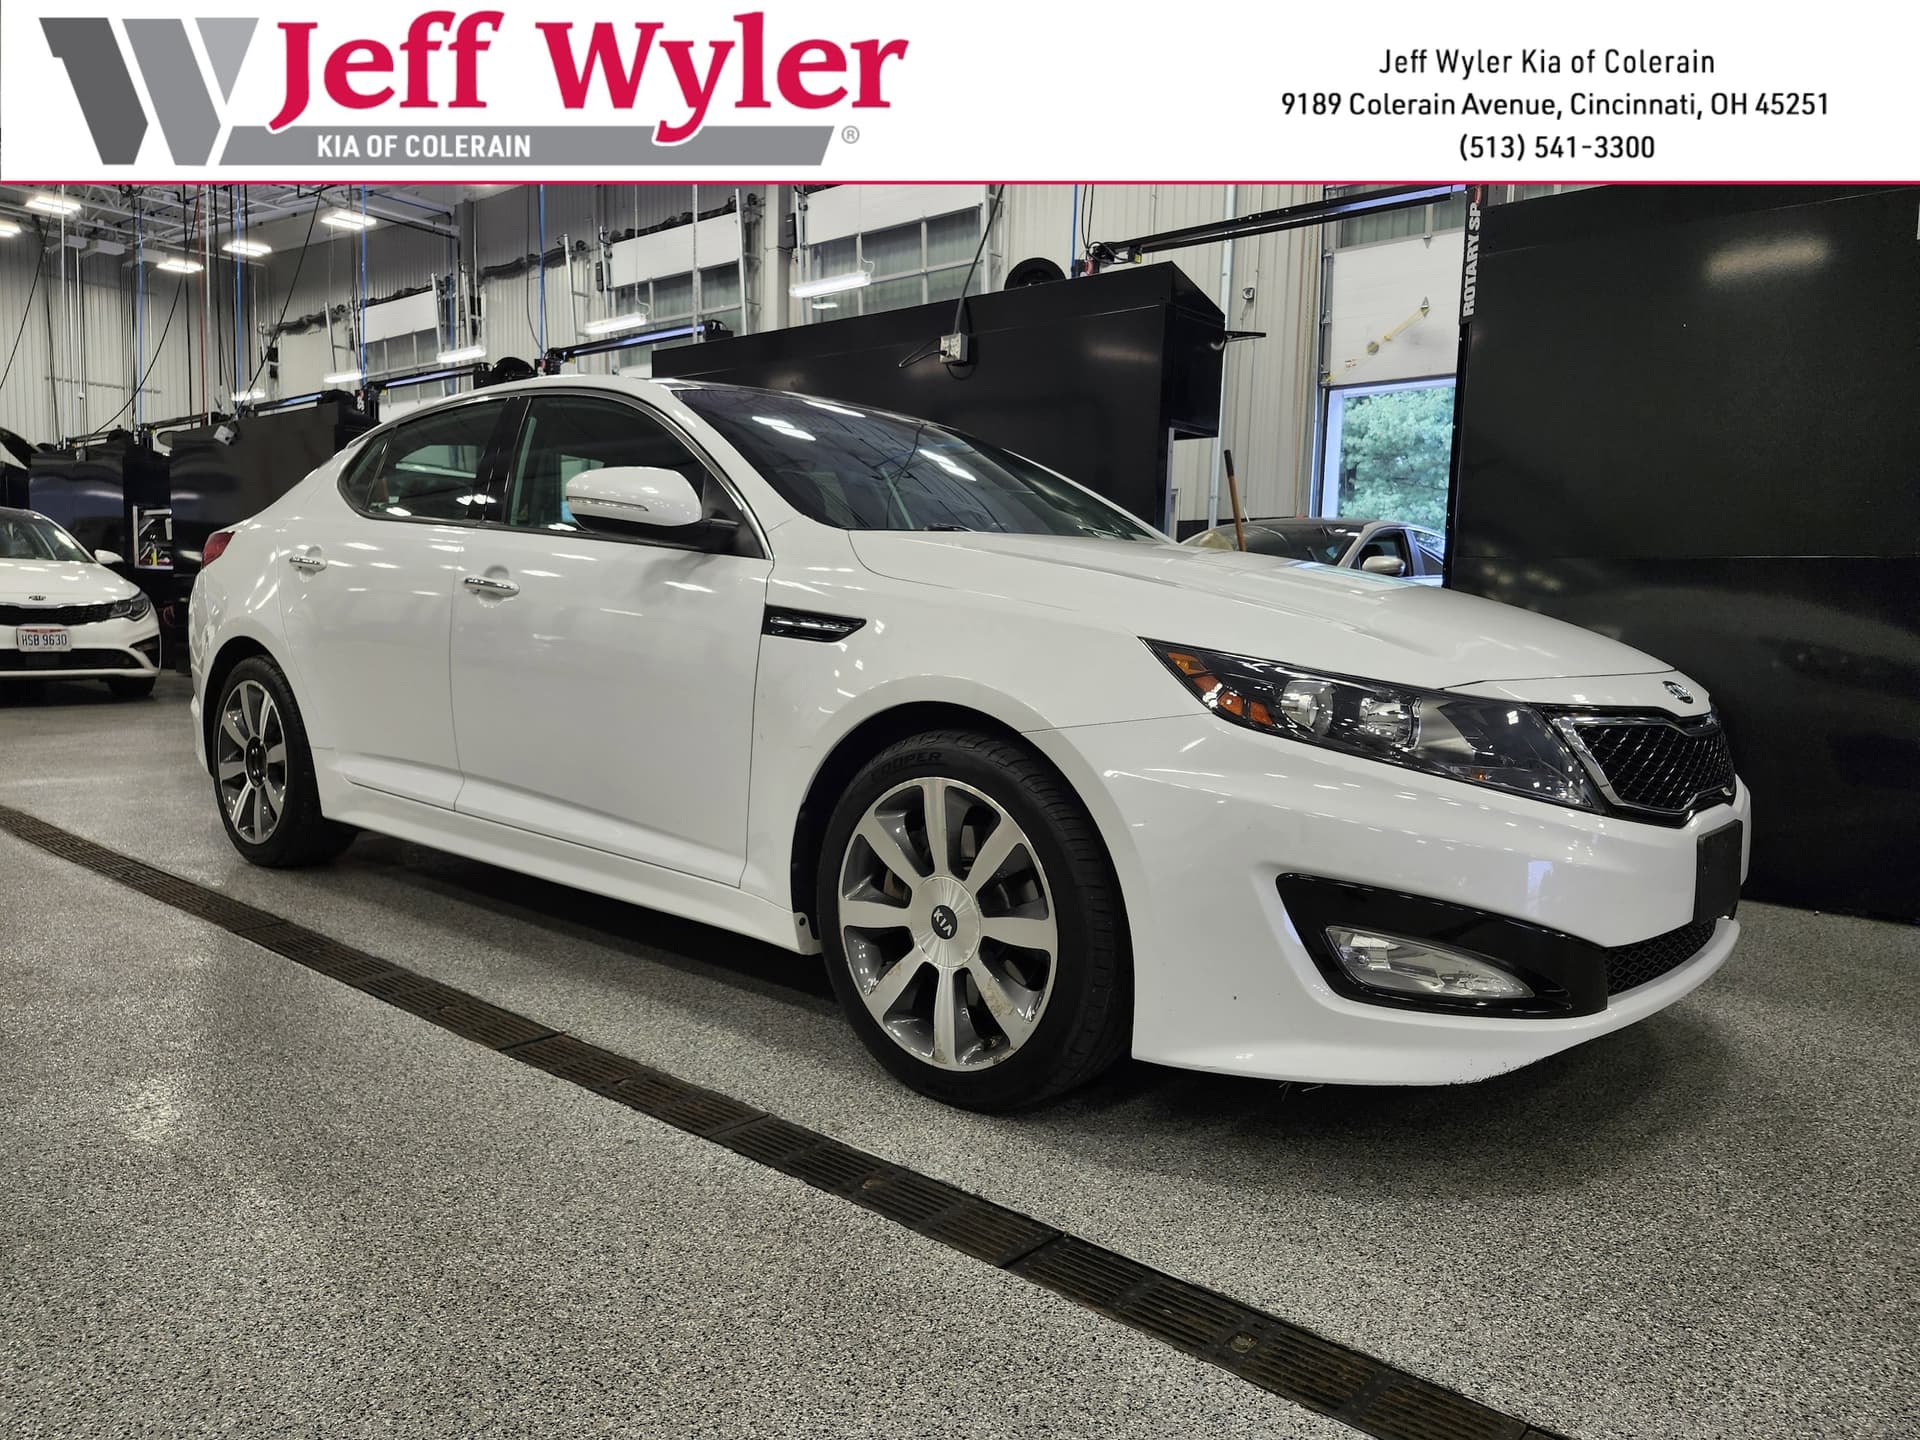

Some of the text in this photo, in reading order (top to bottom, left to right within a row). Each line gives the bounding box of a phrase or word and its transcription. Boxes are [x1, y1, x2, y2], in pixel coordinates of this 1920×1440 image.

[1462, 234, 1480, 317] ROTARY
[21, 634, 68, 646] HSB 9630
[933, 908, 953, 937] KIA
